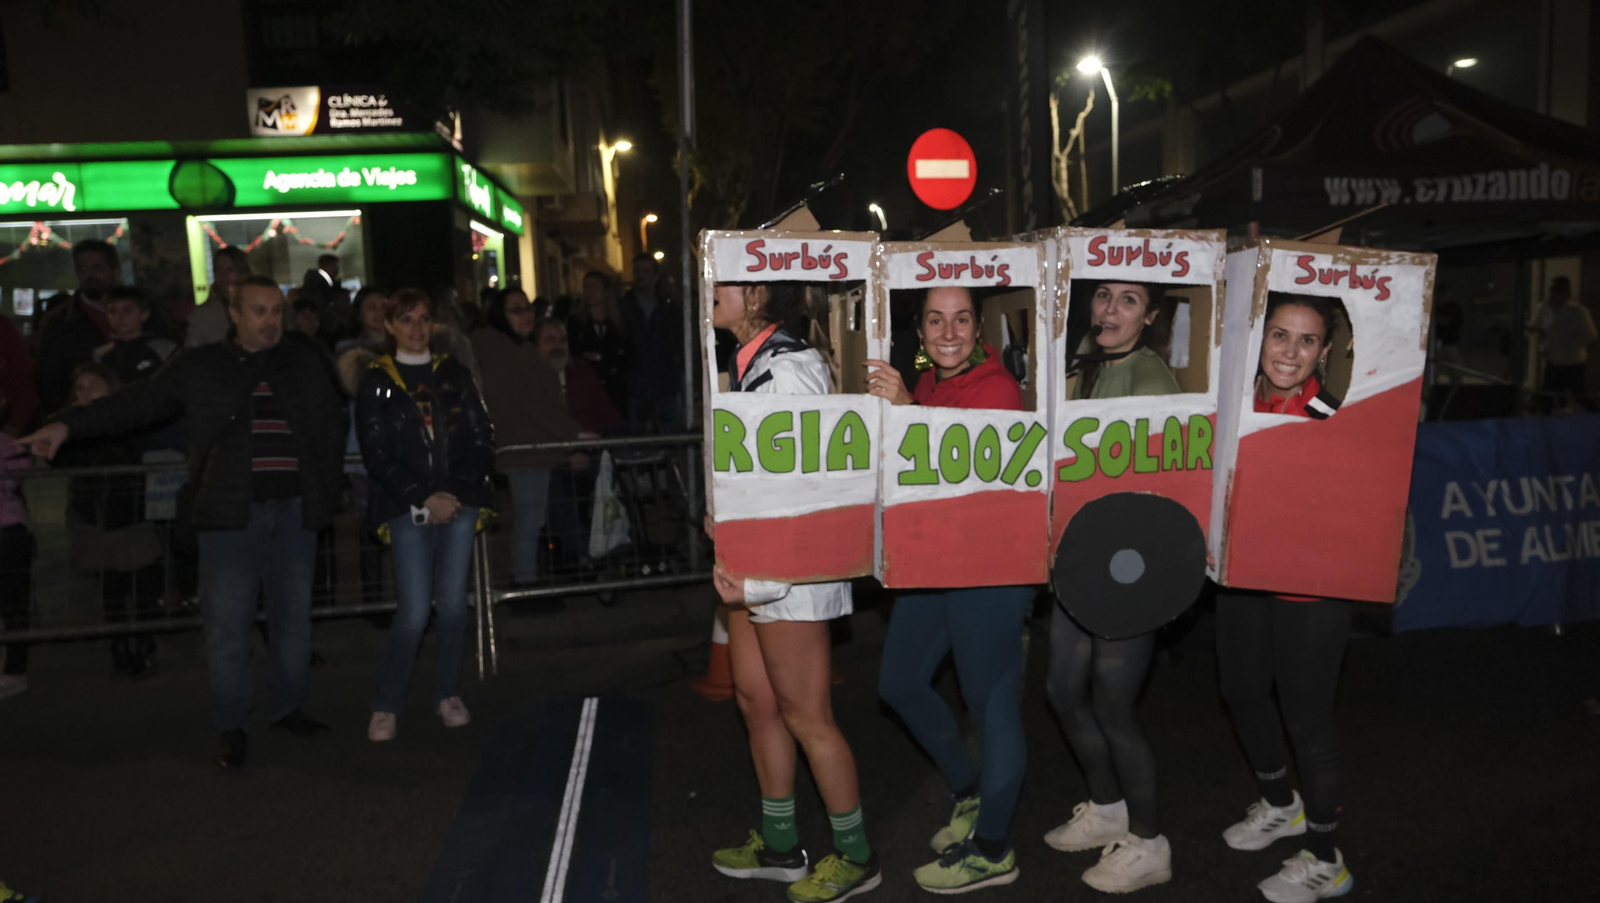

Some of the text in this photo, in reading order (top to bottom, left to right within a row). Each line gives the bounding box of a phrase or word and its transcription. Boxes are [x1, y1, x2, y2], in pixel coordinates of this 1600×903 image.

[327, 93, 377, 108] CLÍNICA
[350, 107, 394, 118] Mercedes
[329, 118, 361, 128] Ramos
[263, 166, 417, 193] Agencia de Viajes
[746, 239, 848, 279] Surbús
[916, 251, 1011, 286] Surbús
[1088, 235, 1190, 277] Surbús
[1295, 254, 1393, 301] Surbús
[713, 408, 1214, 487] RGIA 100% SOLAR
[1444, 528, 1507, 569] DE
